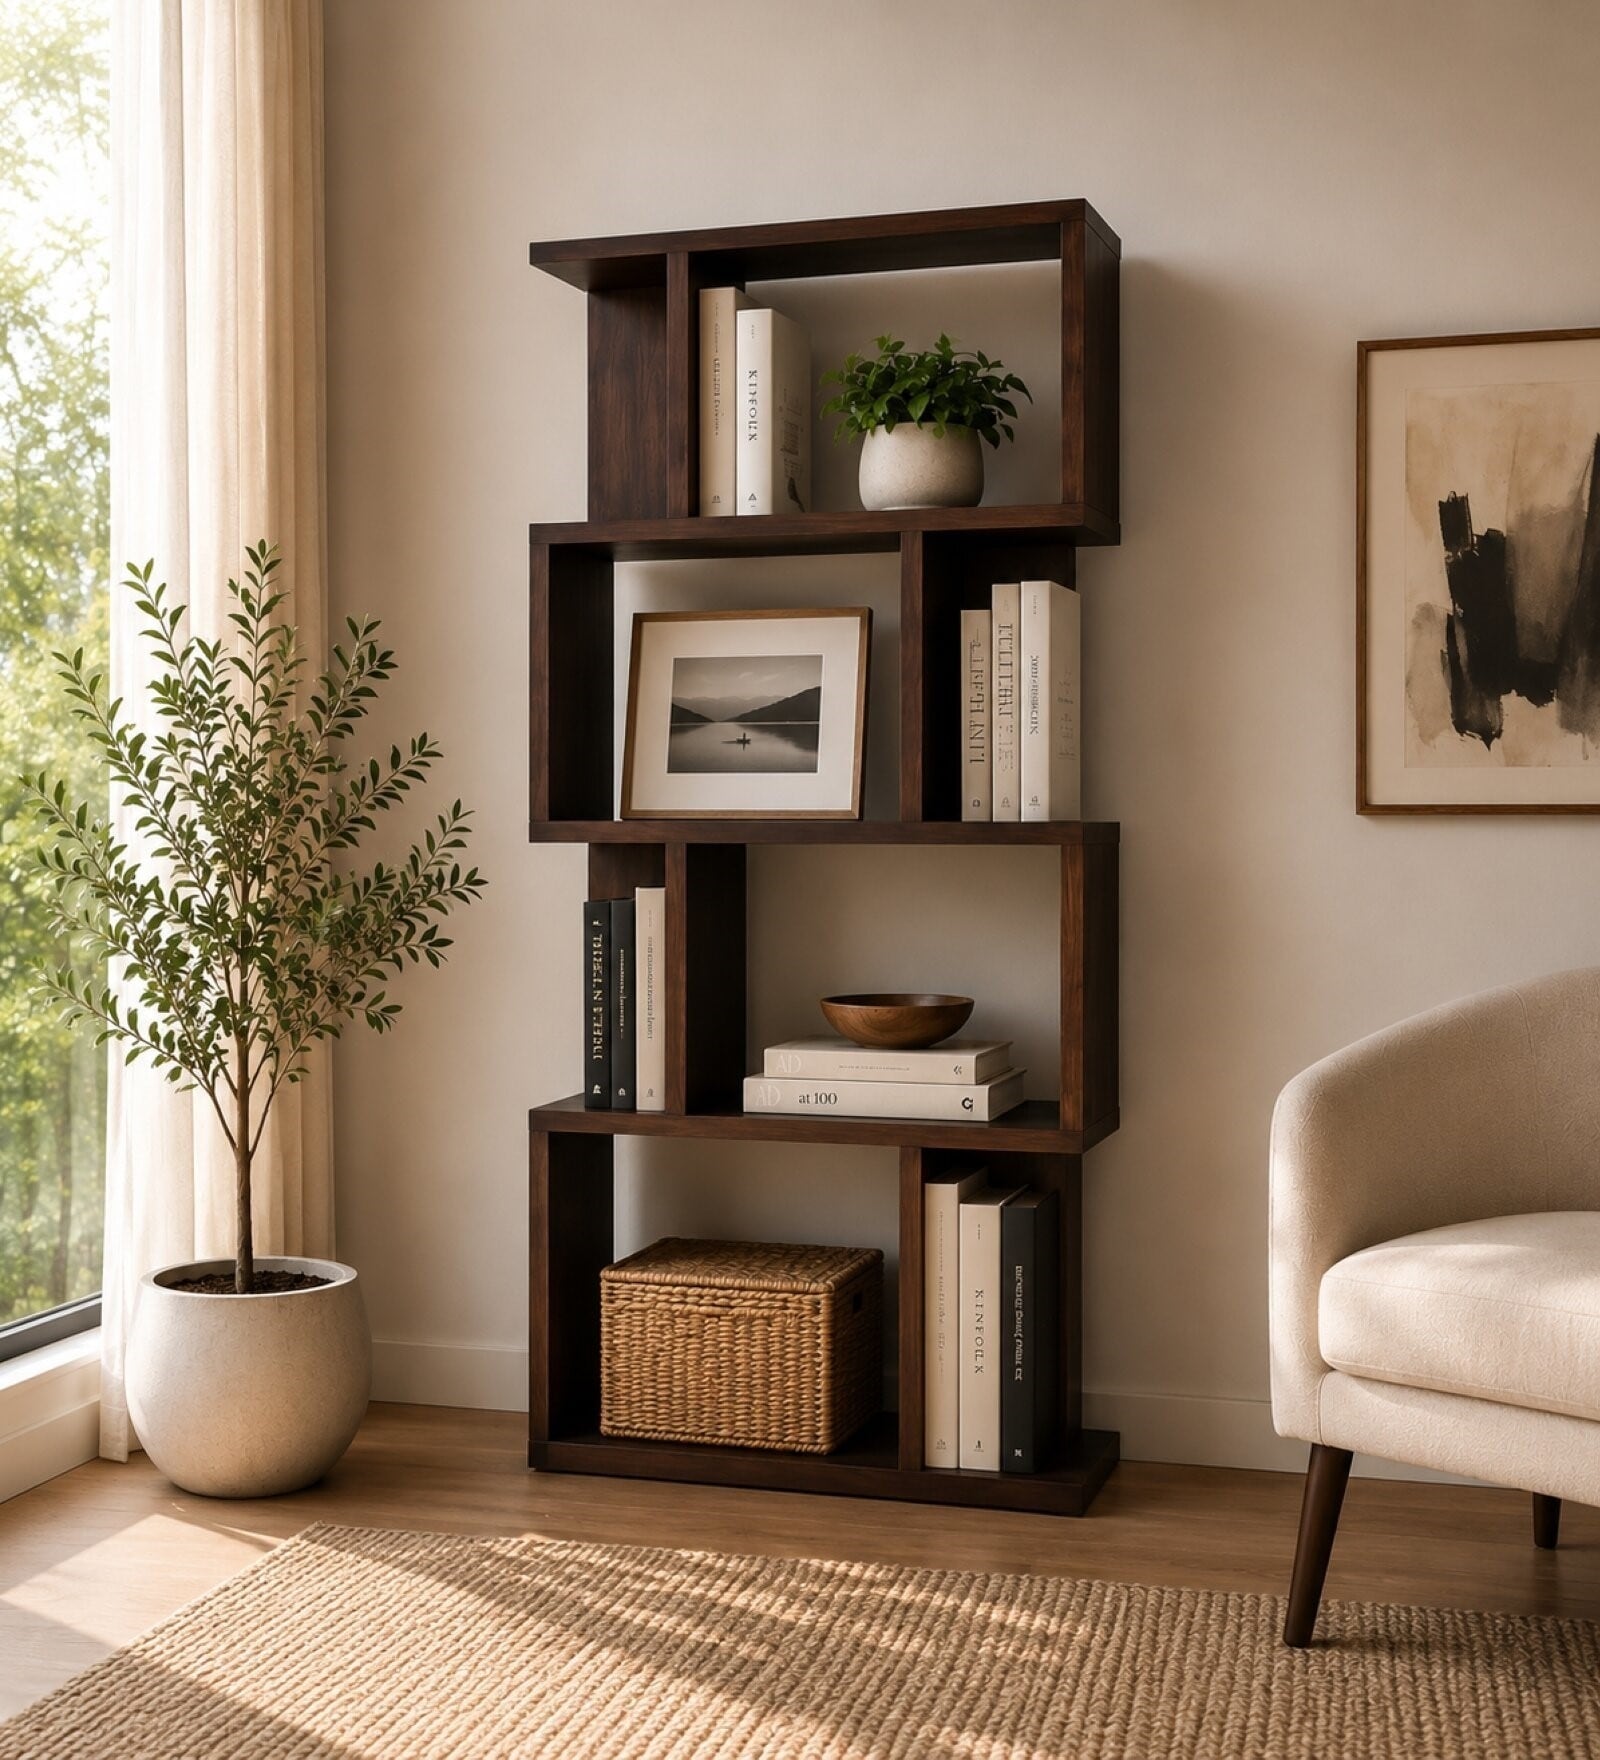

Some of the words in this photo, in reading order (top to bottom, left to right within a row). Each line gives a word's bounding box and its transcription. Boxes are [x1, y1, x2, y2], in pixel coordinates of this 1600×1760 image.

[775, 1055, 802, 1073] AD
[755, 1085, 781, 1106] AD
[798, 1093, 811, 1105] at
[814, 1092, 838, 1105] 100
